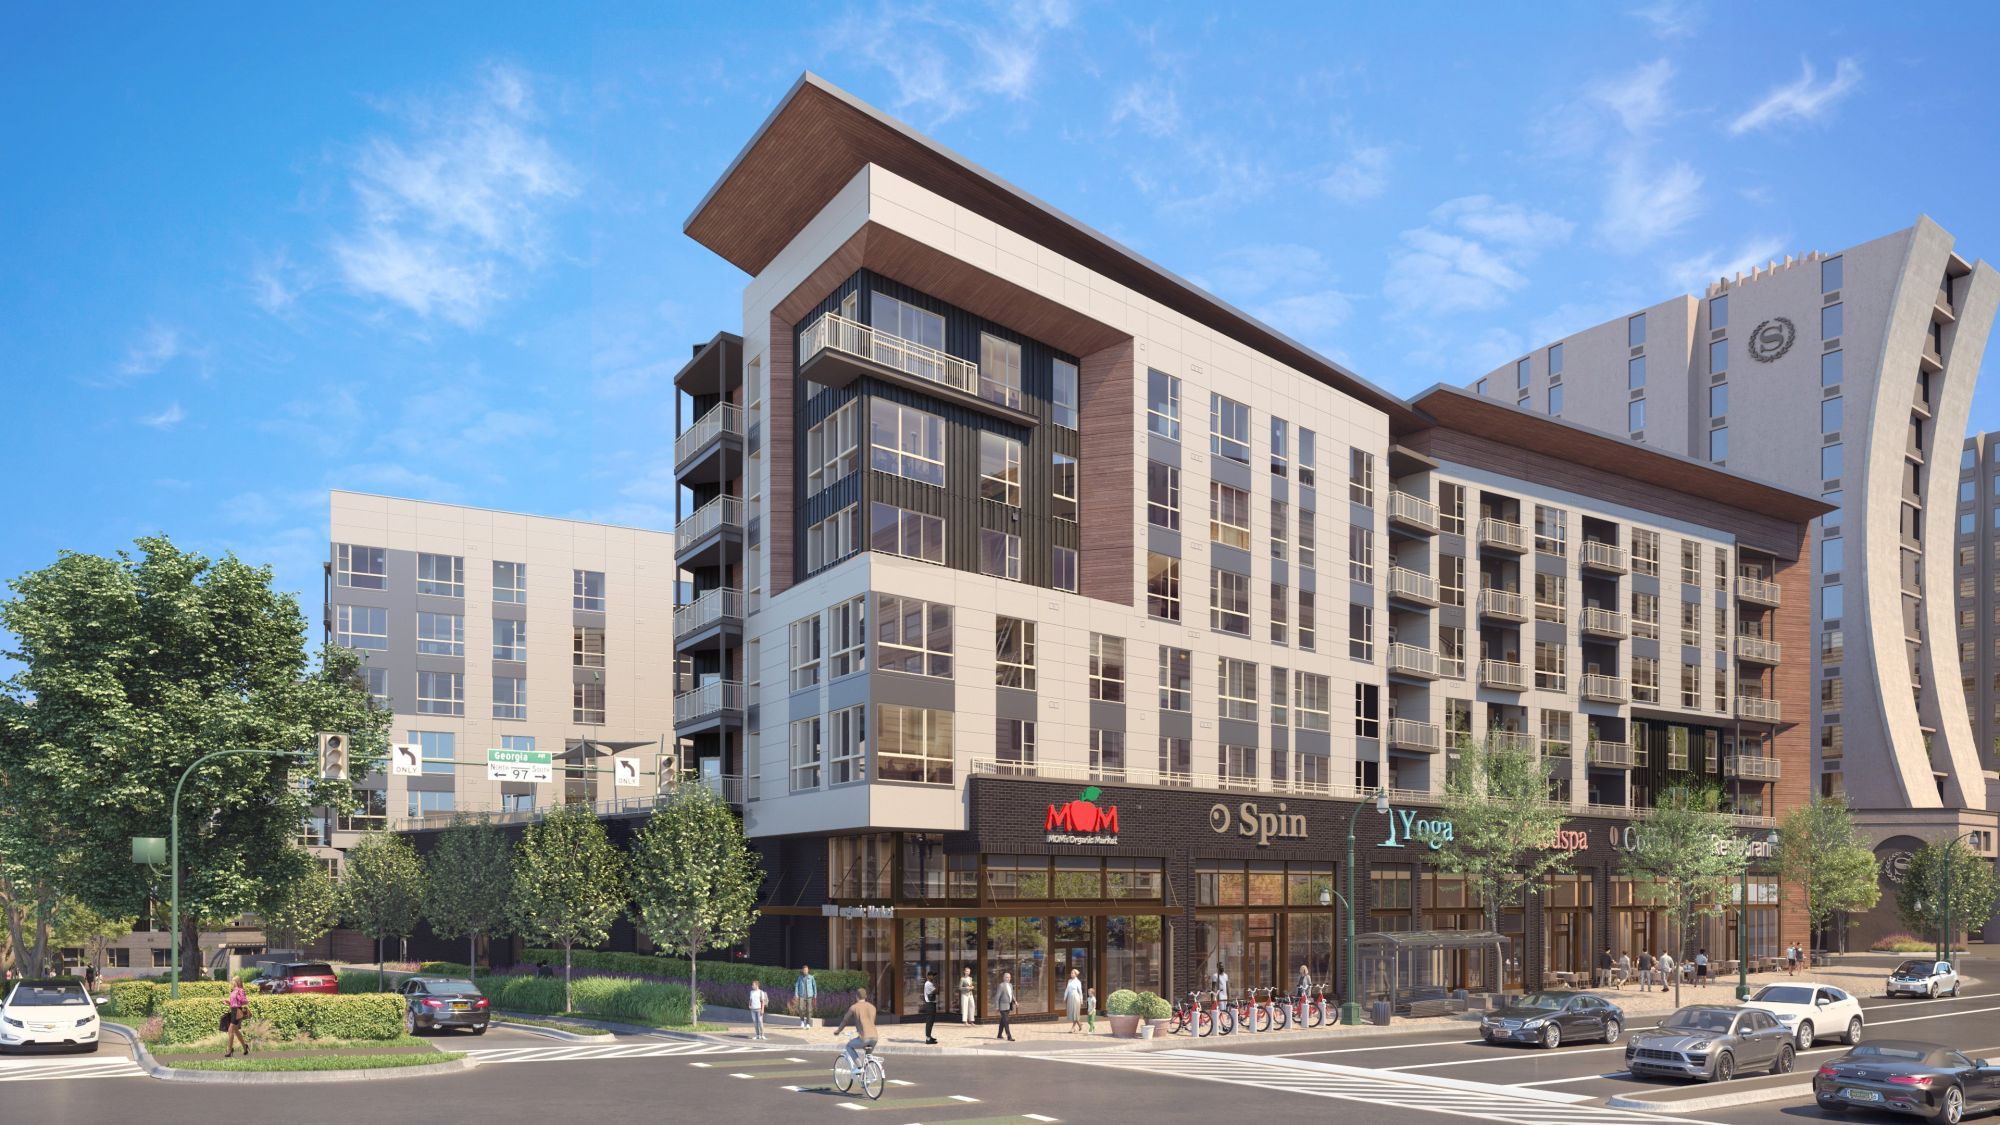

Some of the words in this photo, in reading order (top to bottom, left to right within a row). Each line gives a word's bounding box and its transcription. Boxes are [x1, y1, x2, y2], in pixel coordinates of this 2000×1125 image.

[494, 752, 528, 763] Georgia
[512, 769, 529, 780] 97
[1239, 802, 1309, 846] Spin
[1398, 809, 1455, 850] Yoga
[1068, 835, 1093, 845] Organic
[1094, 835, 1118, 845] Market
